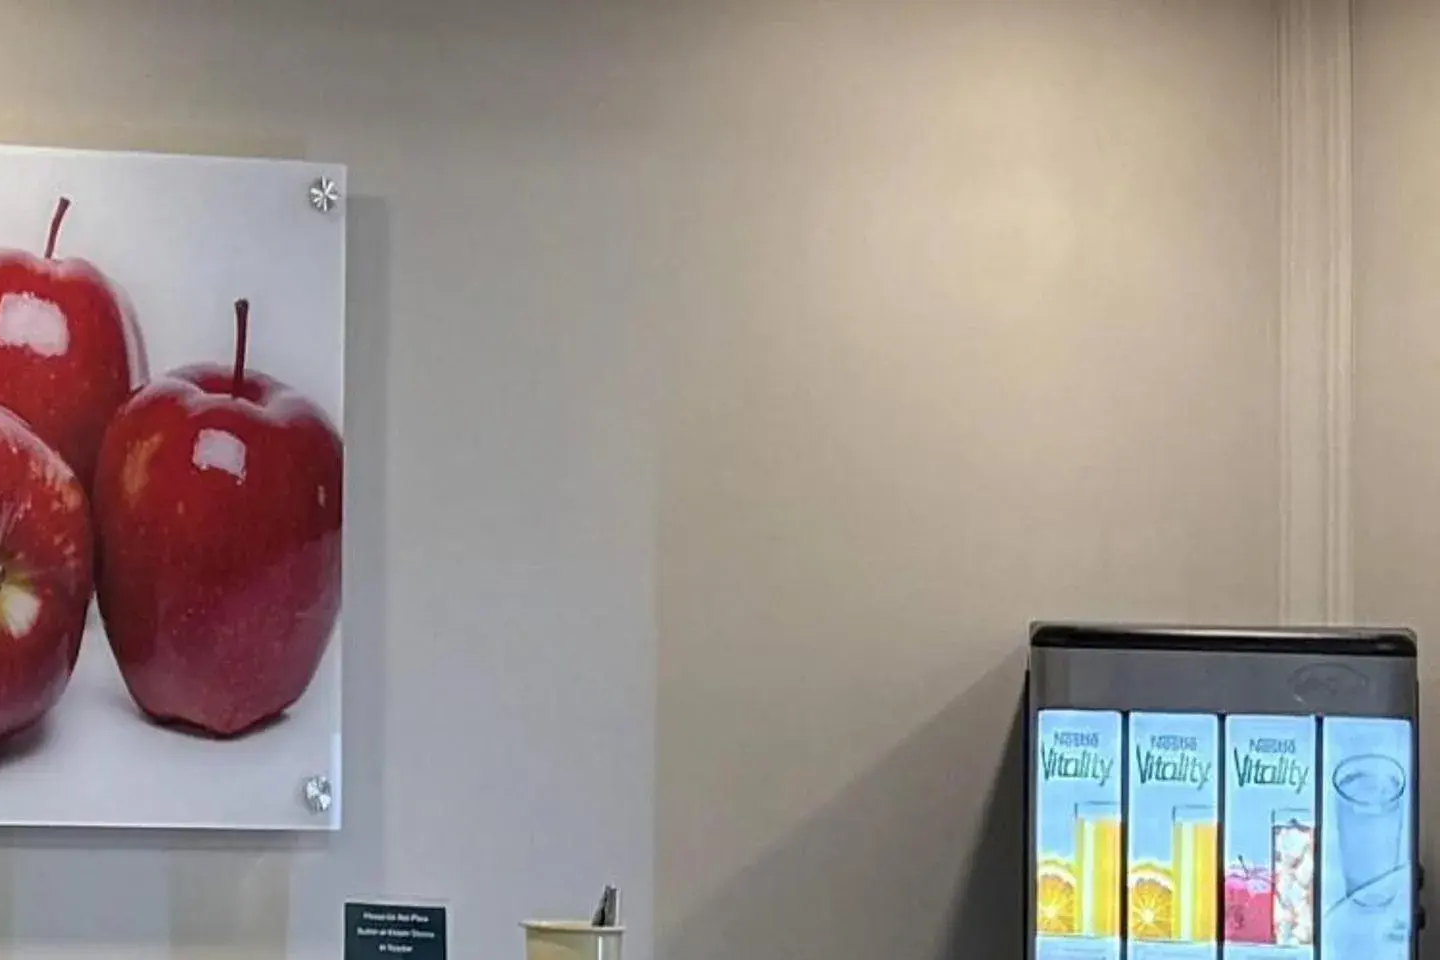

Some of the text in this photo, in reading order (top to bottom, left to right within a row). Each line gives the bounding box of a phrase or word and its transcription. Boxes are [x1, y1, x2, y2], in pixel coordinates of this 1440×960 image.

[1041, 742, 1114, 787] Vitality
[1136, 744, 1212, 791] Vitality
[1234, 747, 1309, 794] Vitality
